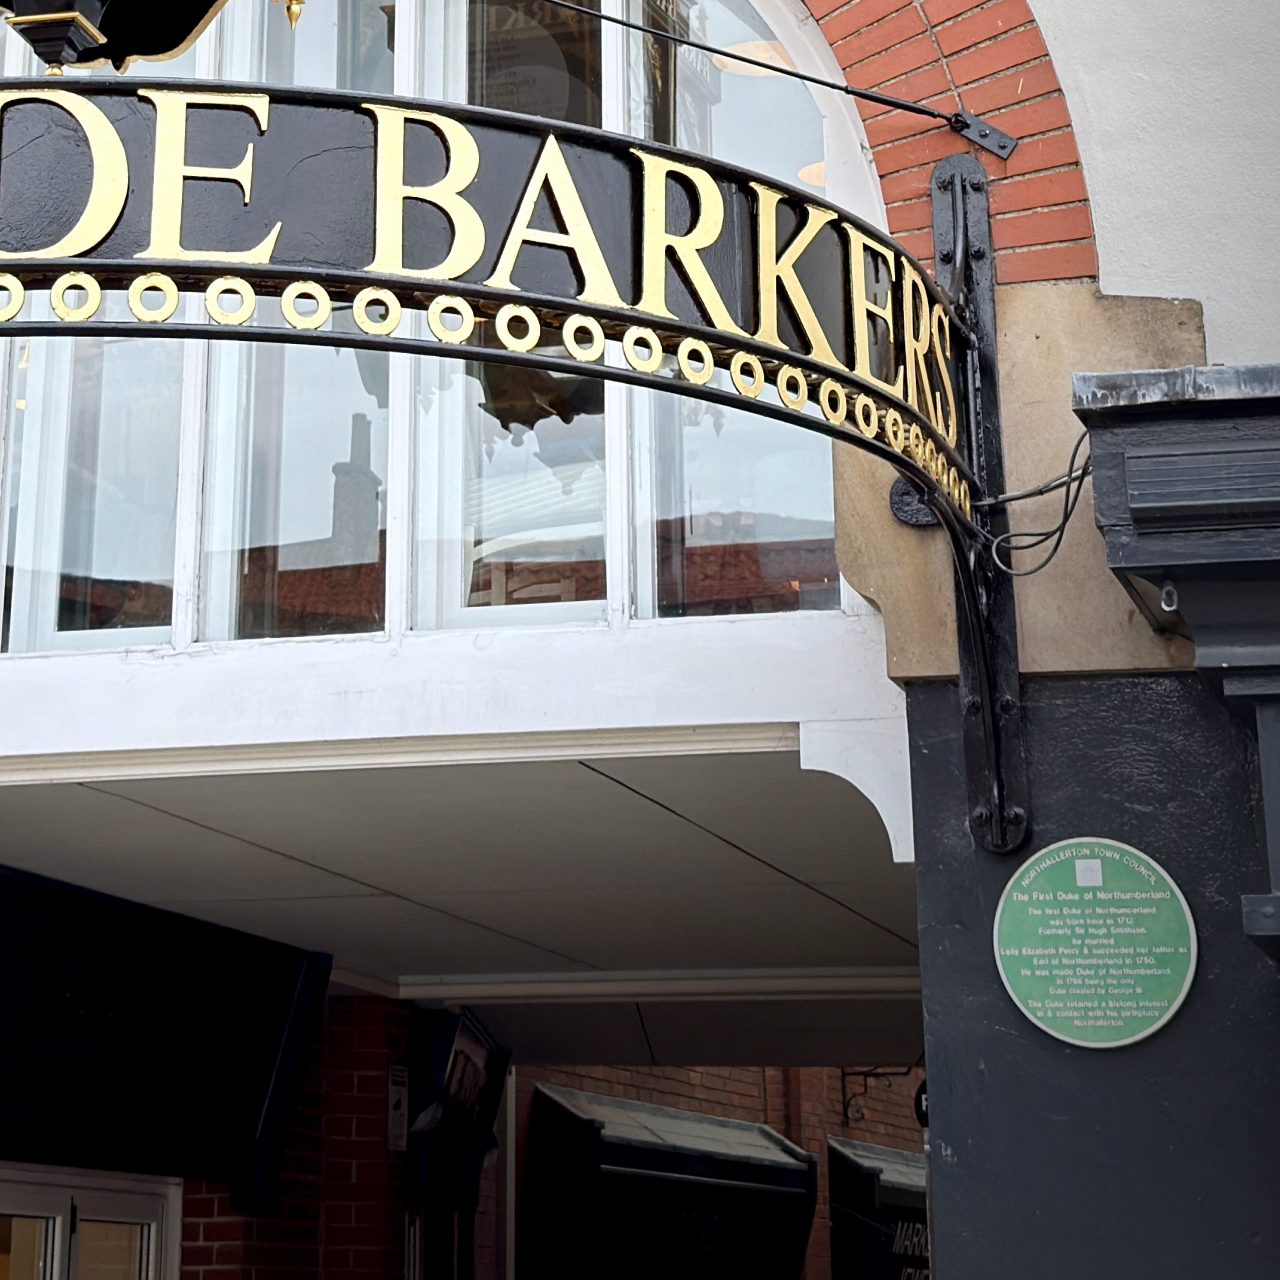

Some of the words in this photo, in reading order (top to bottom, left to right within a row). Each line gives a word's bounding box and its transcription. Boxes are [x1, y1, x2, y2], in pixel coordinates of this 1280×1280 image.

[361, 103, 957, 449] BARKERS
[1021, 847, 1090, 888] NORTHALLERTON
[1095, 848, 1120, 860] TOWN
[1123, 856, 1157, 885] COUNCIL
[1013, 891, 1029, 901] The
[1032, 891, 1053, 900] First
[1057, 891, 1080, 900] Duke
[1083, 890, 1093, 900] of
[1096, 890, 1171, 900] Northumberland
[1062, 906, 1082, 915] Duke
[1096, 906, 1157, 914] Northumberland
[1062, 957, 1123, 965] Northumberland
[1109, 967, 1171, 975] Northumberland
